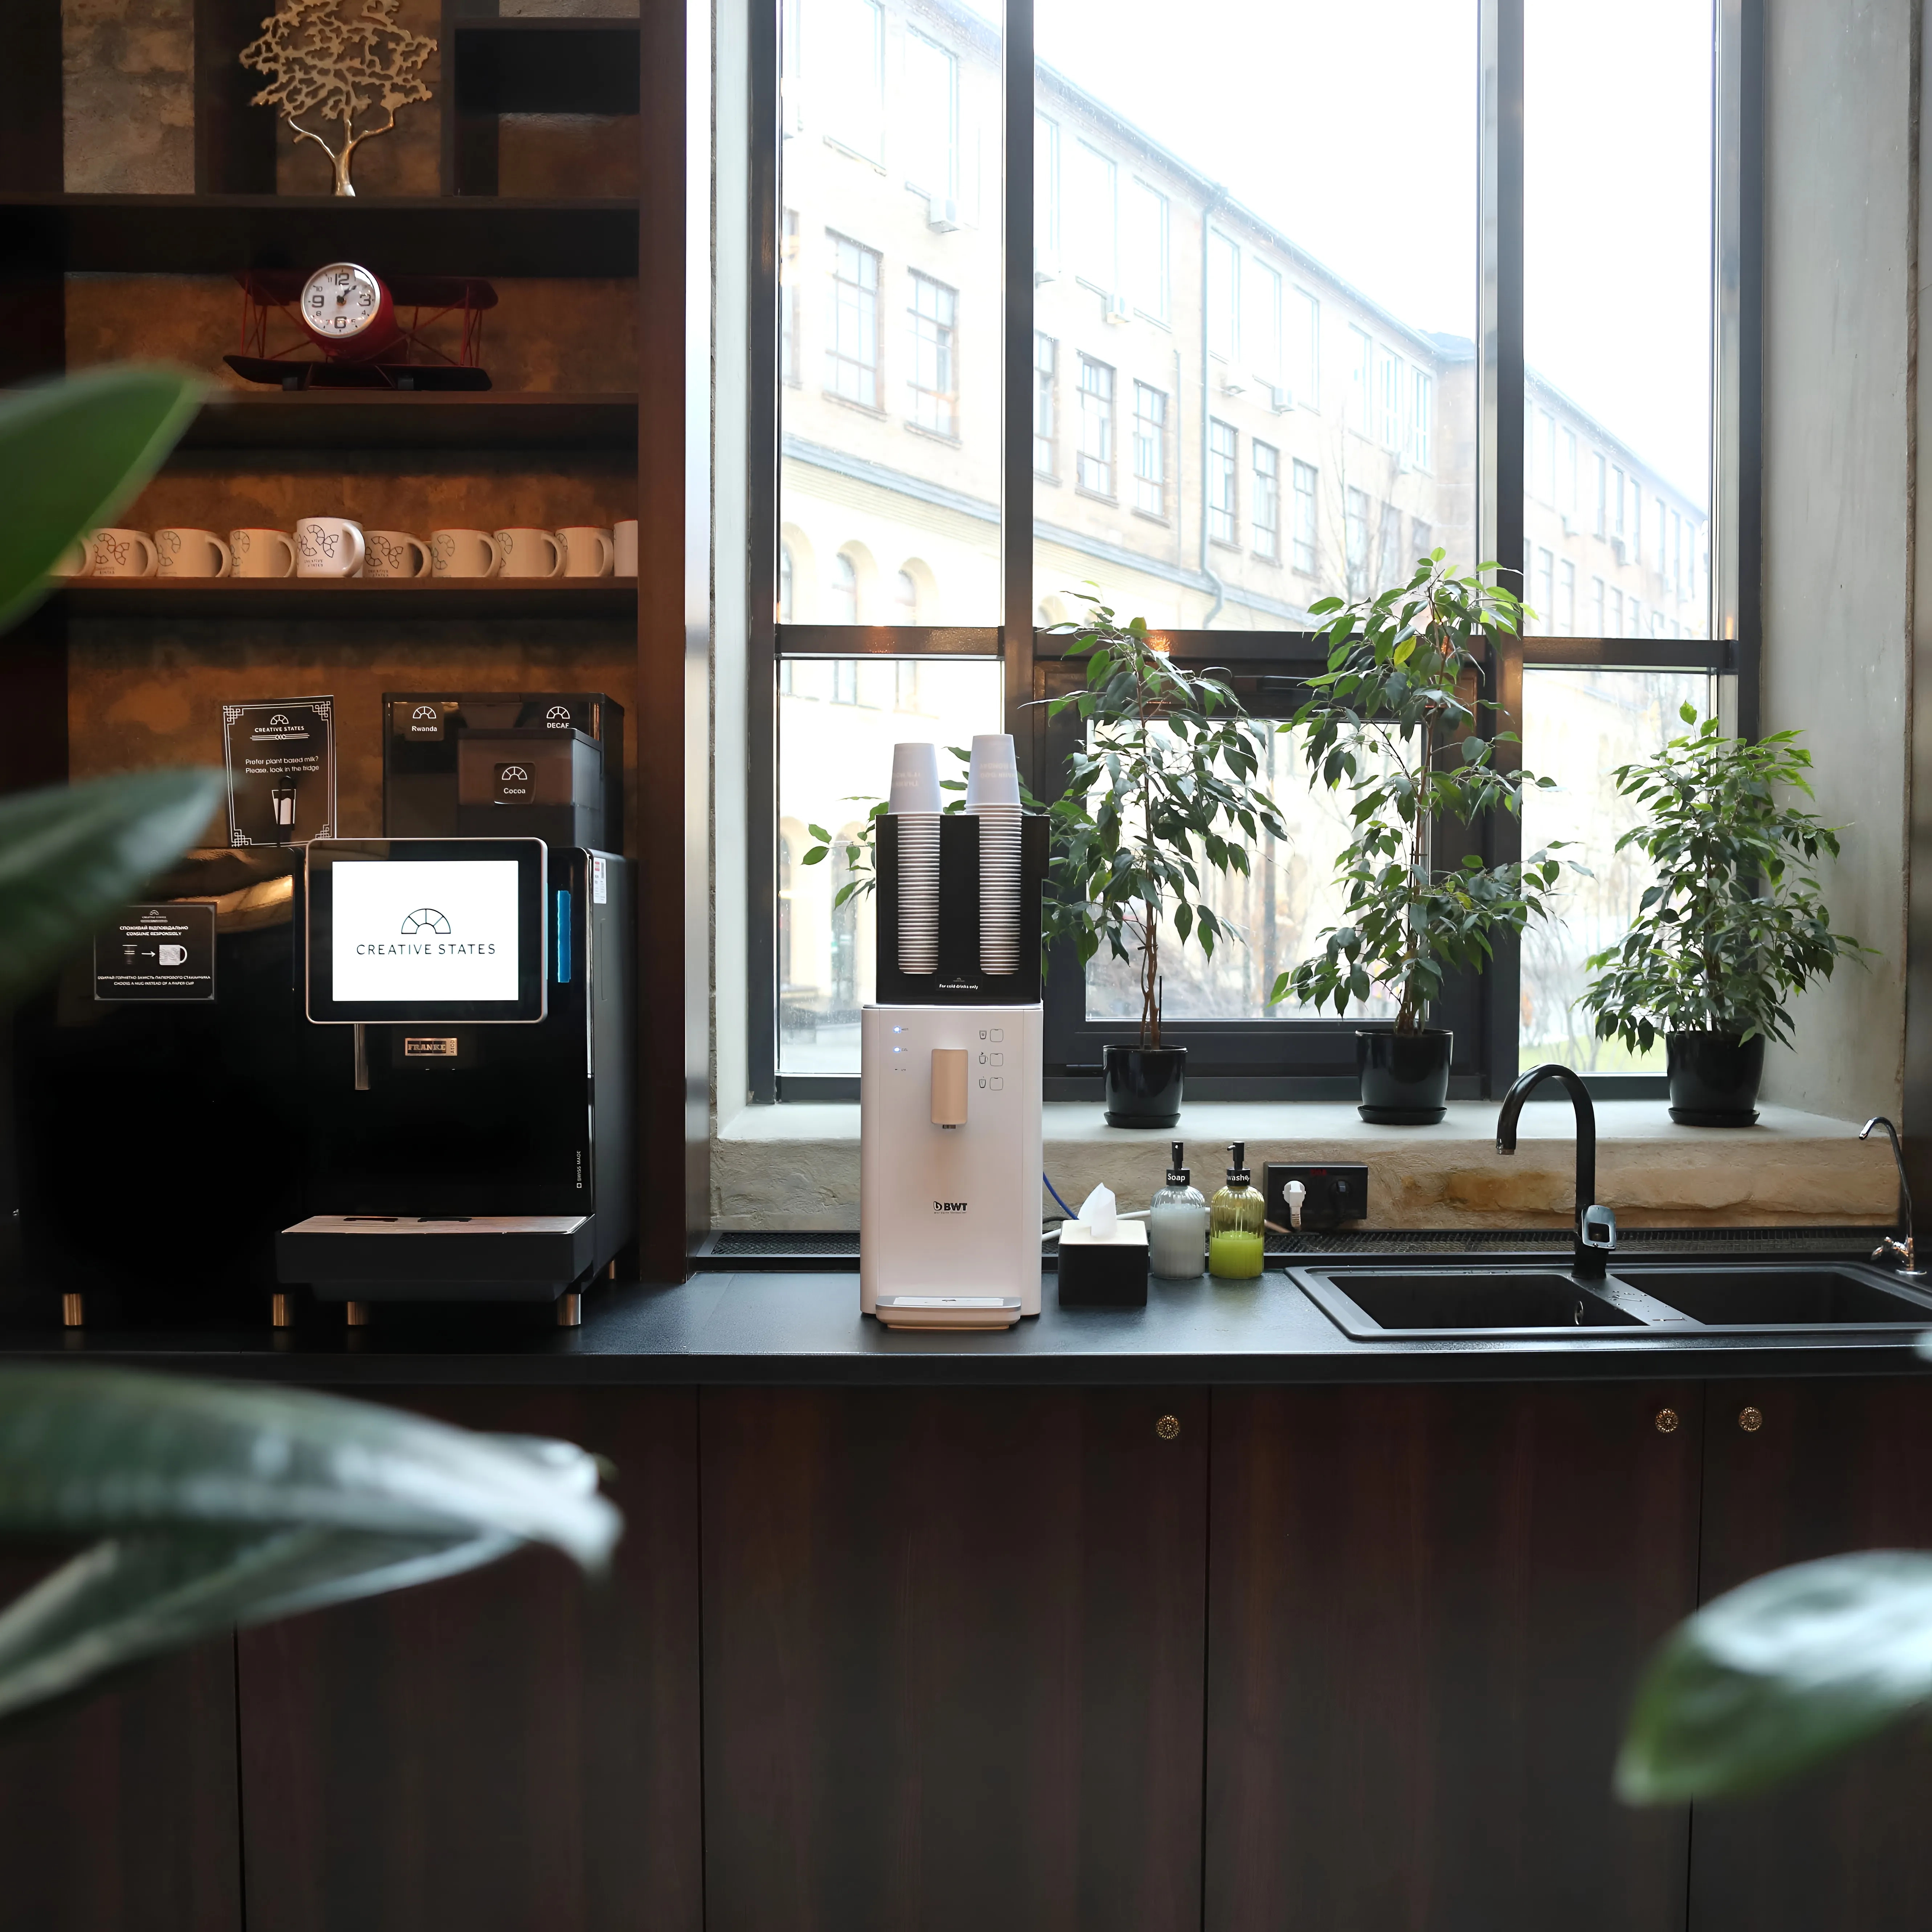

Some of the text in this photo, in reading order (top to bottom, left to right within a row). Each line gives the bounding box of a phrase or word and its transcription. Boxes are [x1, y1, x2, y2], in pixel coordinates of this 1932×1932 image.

[335, 273, 350, 286] 12
[311, 295, 325, 308] 9
[358, 294, 371, 306] 3
[334, 316, 347, 329] 6
[356, 944, 495, 955] CREATIVE STATES
[1168, 1173, 1185, 1182] Soap
[944, 1202, 967, 1211] BWT
